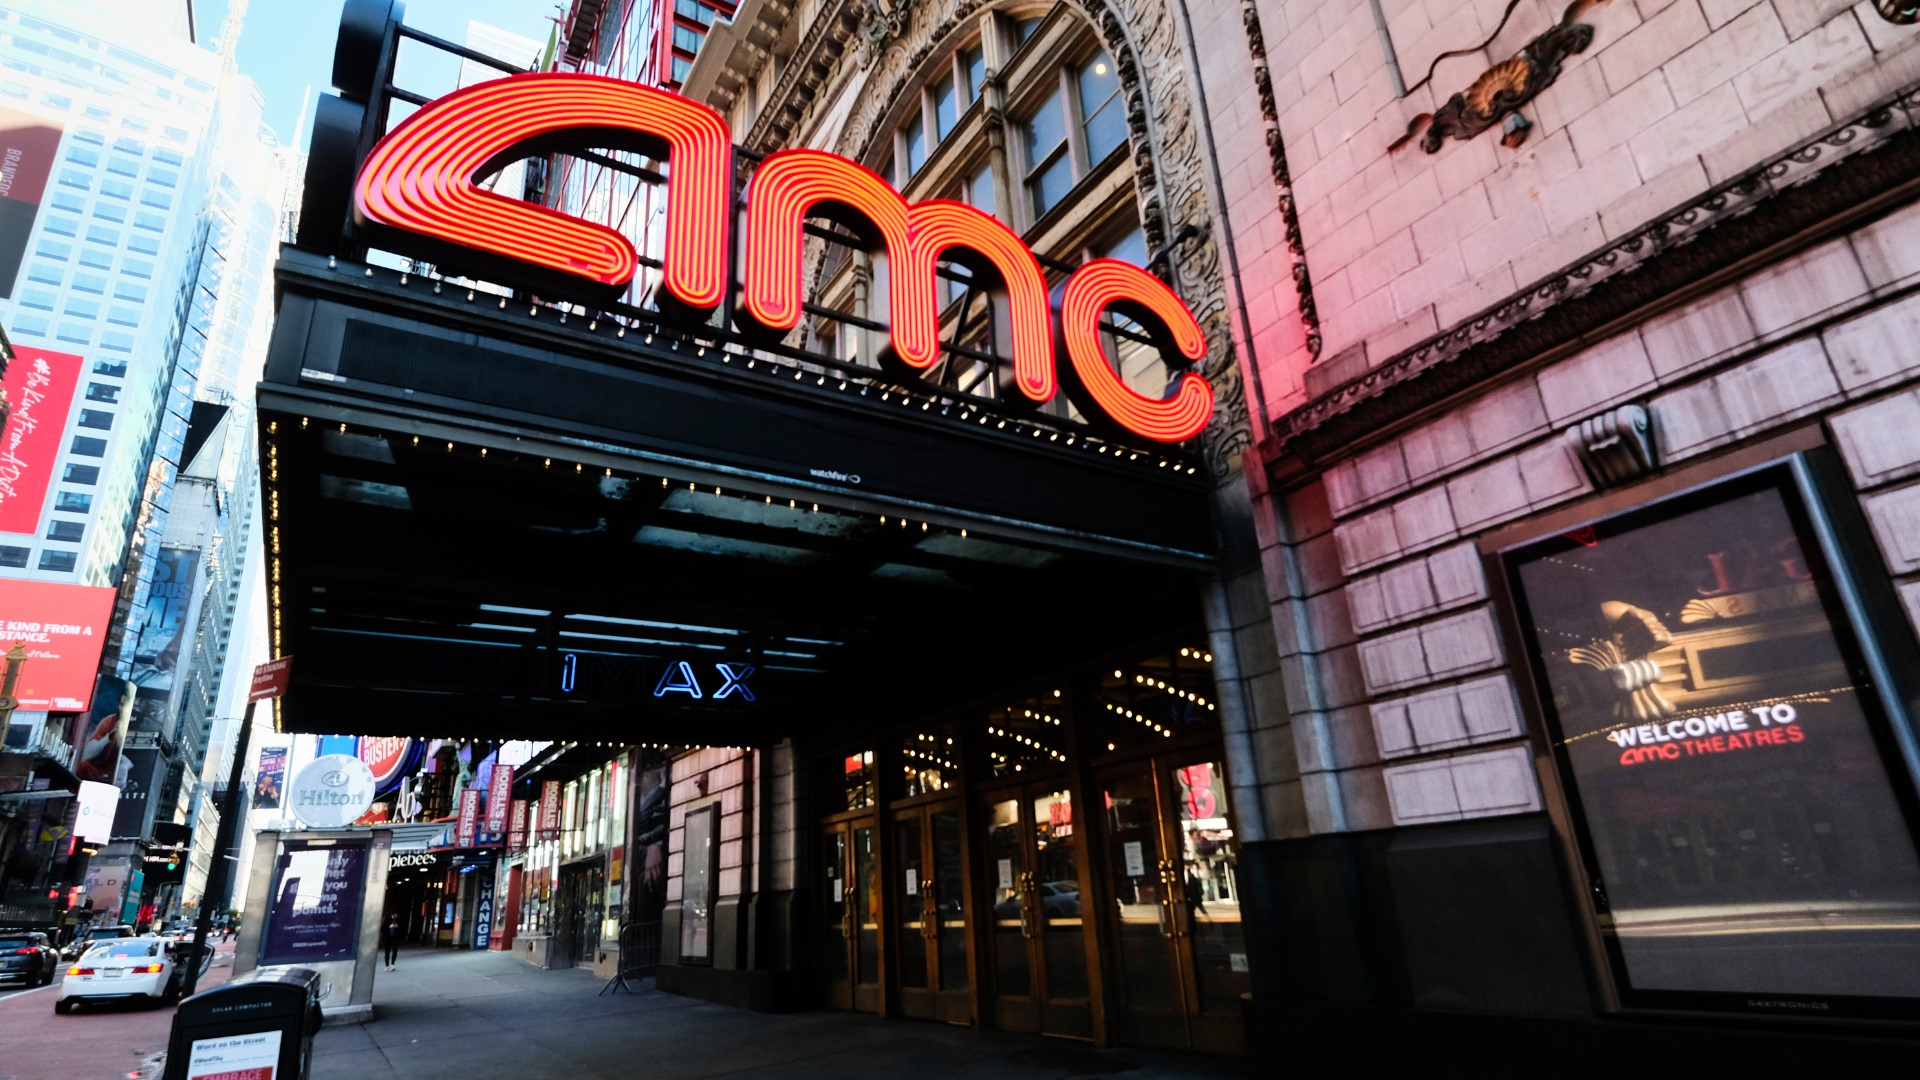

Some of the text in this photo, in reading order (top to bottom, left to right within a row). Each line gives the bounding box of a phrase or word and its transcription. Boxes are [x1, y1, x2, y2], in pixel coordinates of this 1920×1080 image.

[354, 71, 1215, 443] amc
[7, 621, 40, 632] KIND
[43, 623, 81, 635] FROM
[82, 626, 92, 636] A
[1612, 703, 1797, 748] WELCOME TO
[1682, 725, 1805, 756] THEATRES
[299, 789, 364, 806] Hilton
[494, 766, 511, 819] MODELL'S
[464, 791, 478, 836] MODELL'S
[212, 1001, 272, 1013] SOLAR COMPACTOR
[196, 1042, 217, 1051] Word
[243, 1037, 266, 1045] Street
